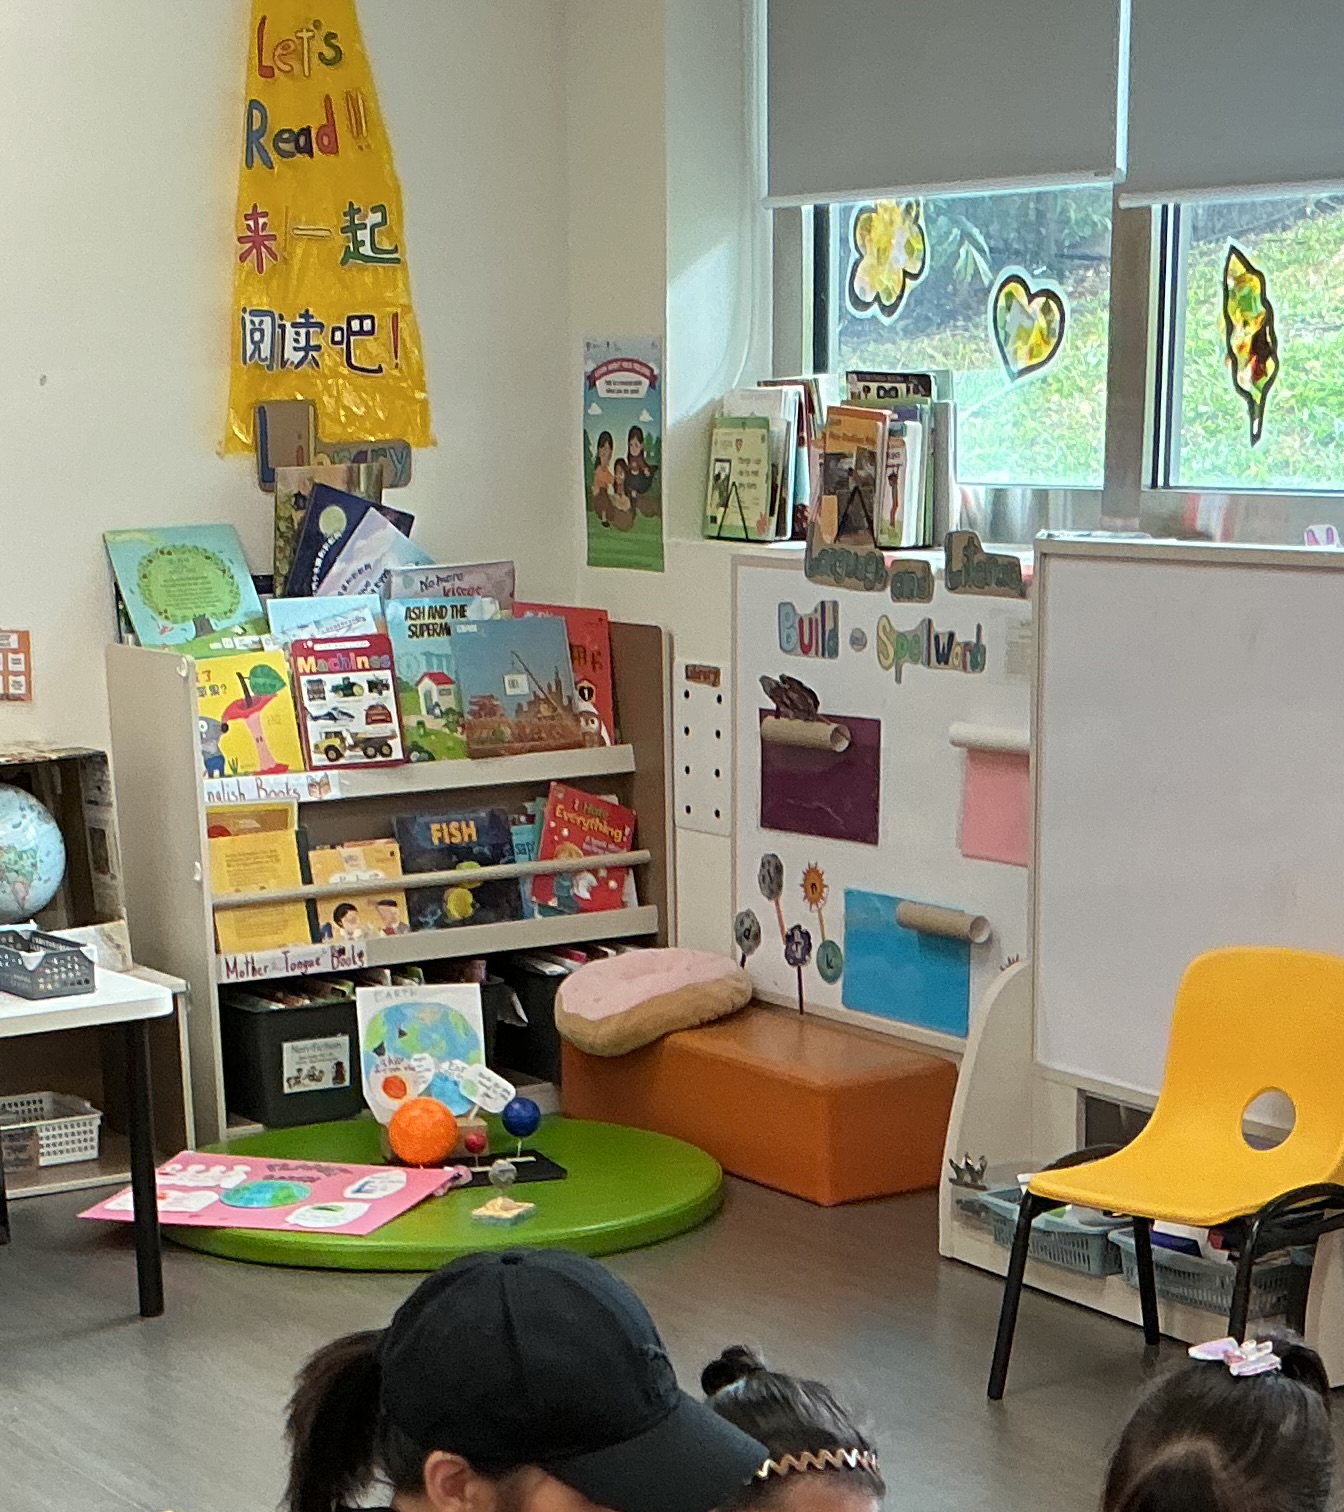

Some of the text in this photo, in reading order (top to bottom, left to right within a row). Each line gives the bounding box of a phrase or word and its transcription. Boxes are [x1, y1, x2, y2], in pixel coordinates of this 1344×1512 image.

[256, 15, 343, 78] Let's
[238, 201, 402, 275] 来一起
[405, 604, 468, 621] ASH AND THE
[256, 776, 301, 799] Books
[430, 820, 478, 845] FISH
[224, 954, 269, 980] Mother
[281, 949, 321, 973] Tongue
